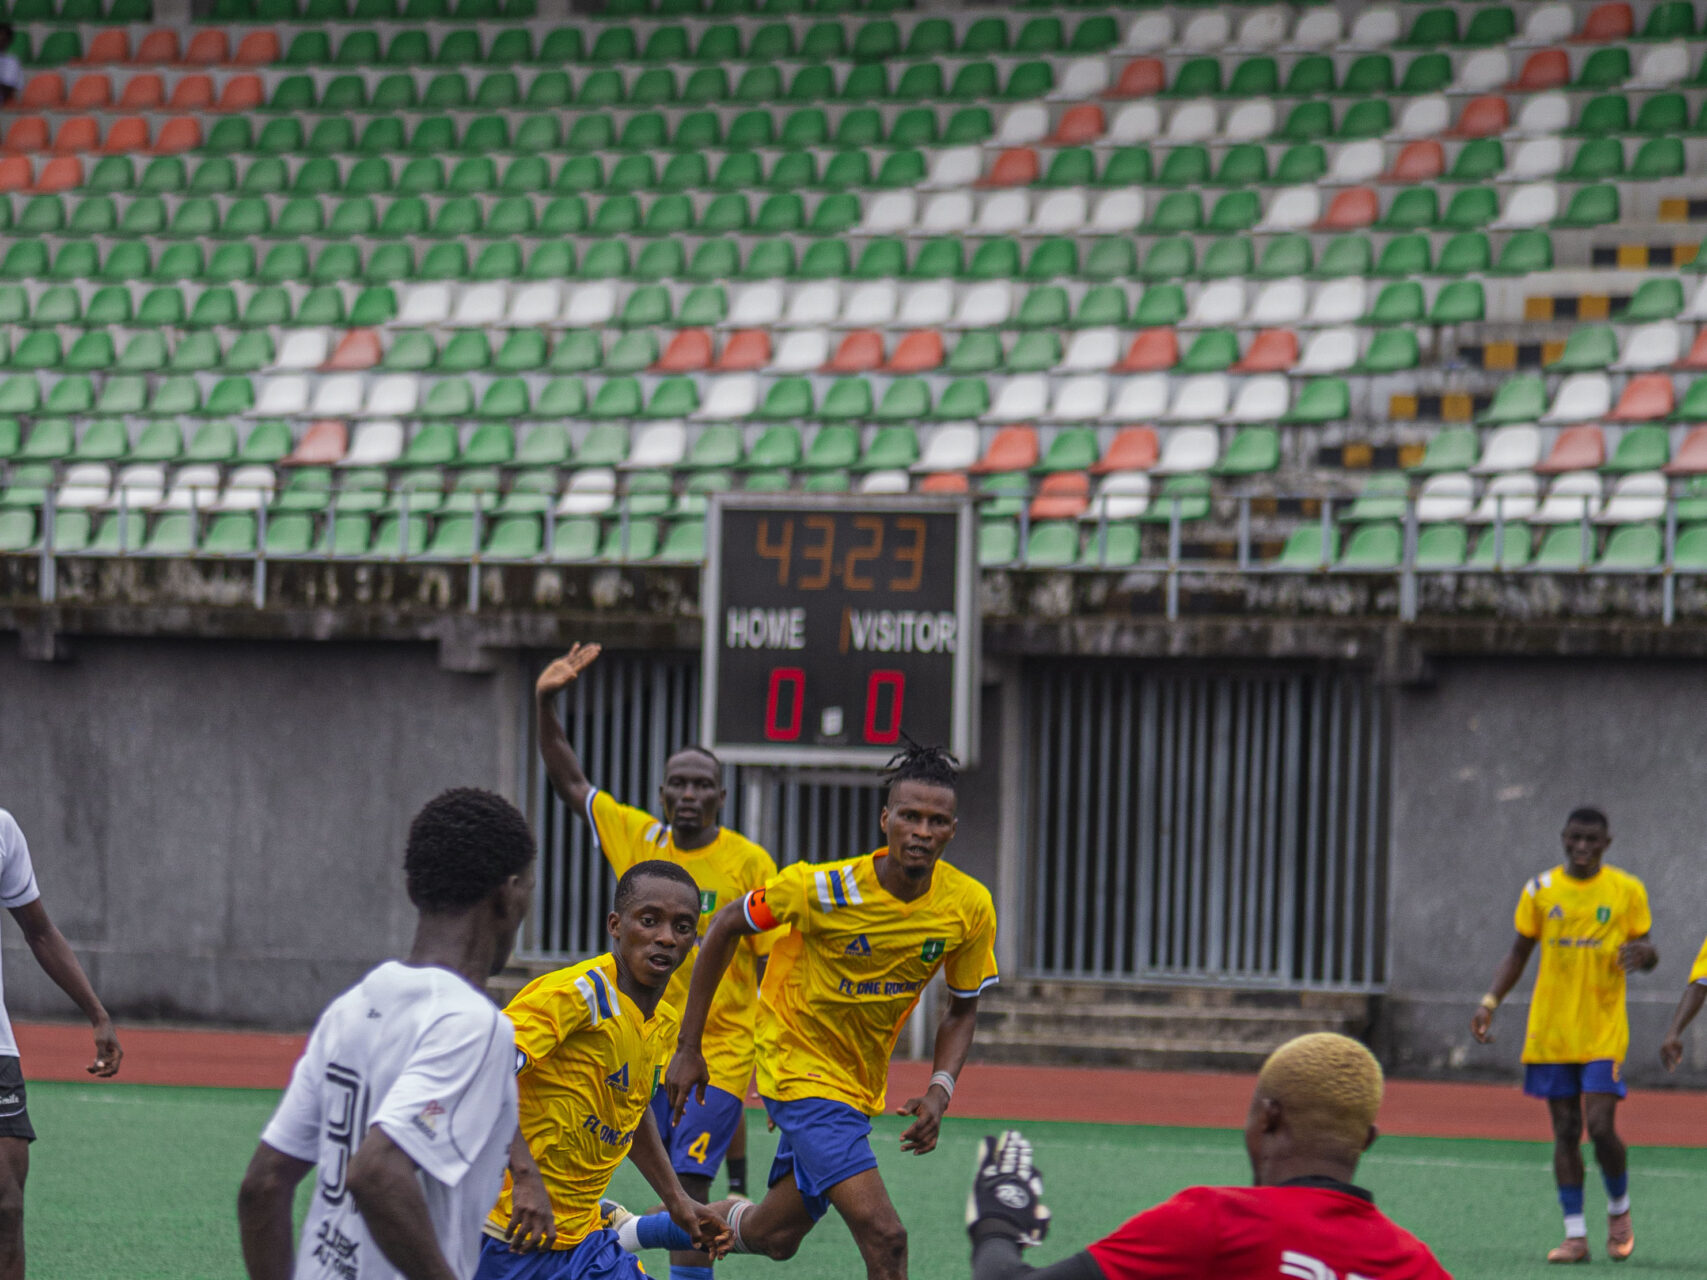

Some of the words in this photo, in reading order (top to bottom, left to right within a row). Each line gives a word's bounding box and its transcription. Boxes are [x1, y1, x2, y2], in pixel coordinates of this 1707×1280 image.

[727, 606, 806, 649] HOME
[850, 609, 957, 653] VISITOR
[765, 667, 805, 741] 0
[864, 670, 905, 744] 0
[839, 978, 854, 994] FC
[857, 982, 880, 994] ONE
[688, 1132, 711, 1164] 4
